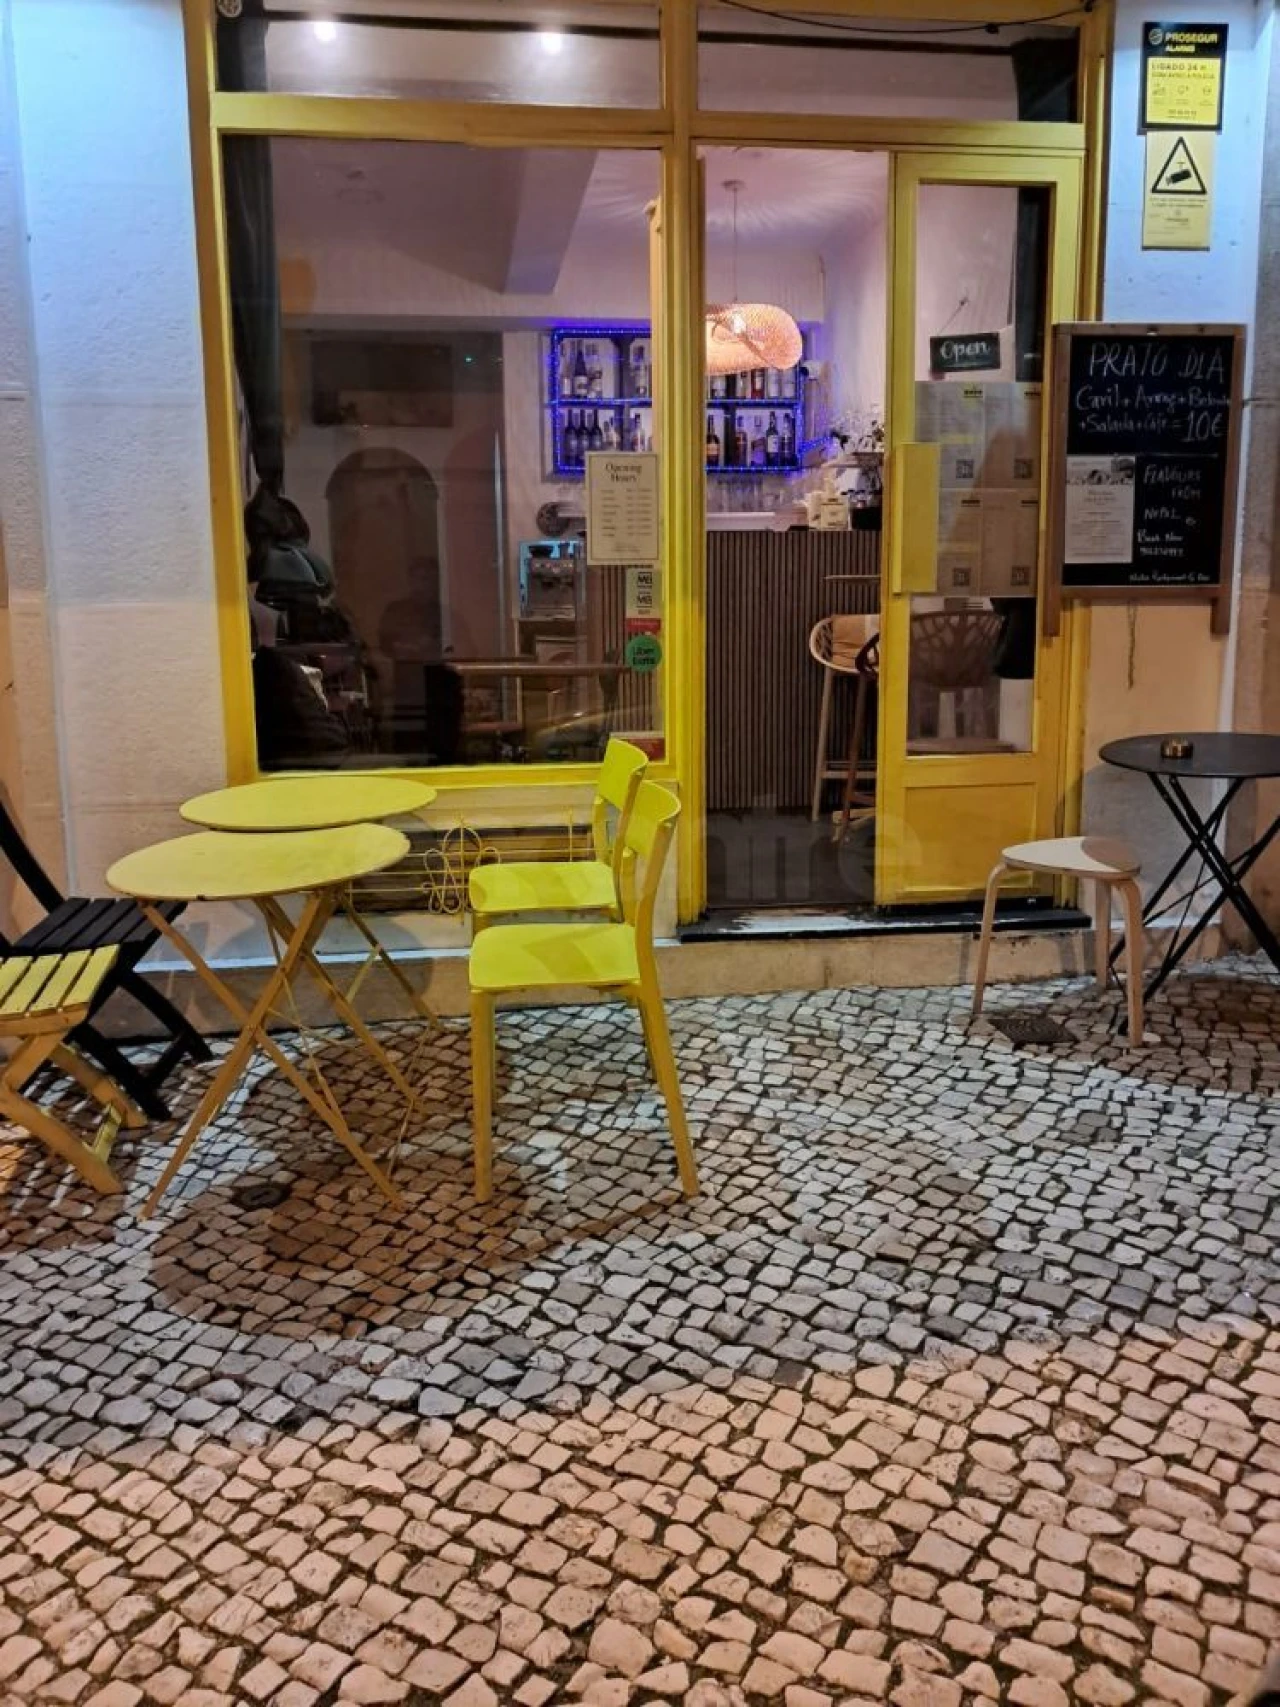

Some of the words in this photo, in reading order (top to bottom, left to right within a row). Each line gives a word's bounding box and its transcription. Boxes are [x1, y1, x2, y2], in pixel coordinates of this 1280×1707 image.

[1165, 32, 1218, 44] PROSEGUR
[939, 339, 990, 362] Open
[1089, 342, 1169, 377] PRATO
[1178, 346, 1225, 384] DIA
[1181, 410, 1224, 443] 10€
[604, 463, 643, 475] Opening
[610, 474, 638, 483] Hours
[632, 646, 655, 657] Uber
